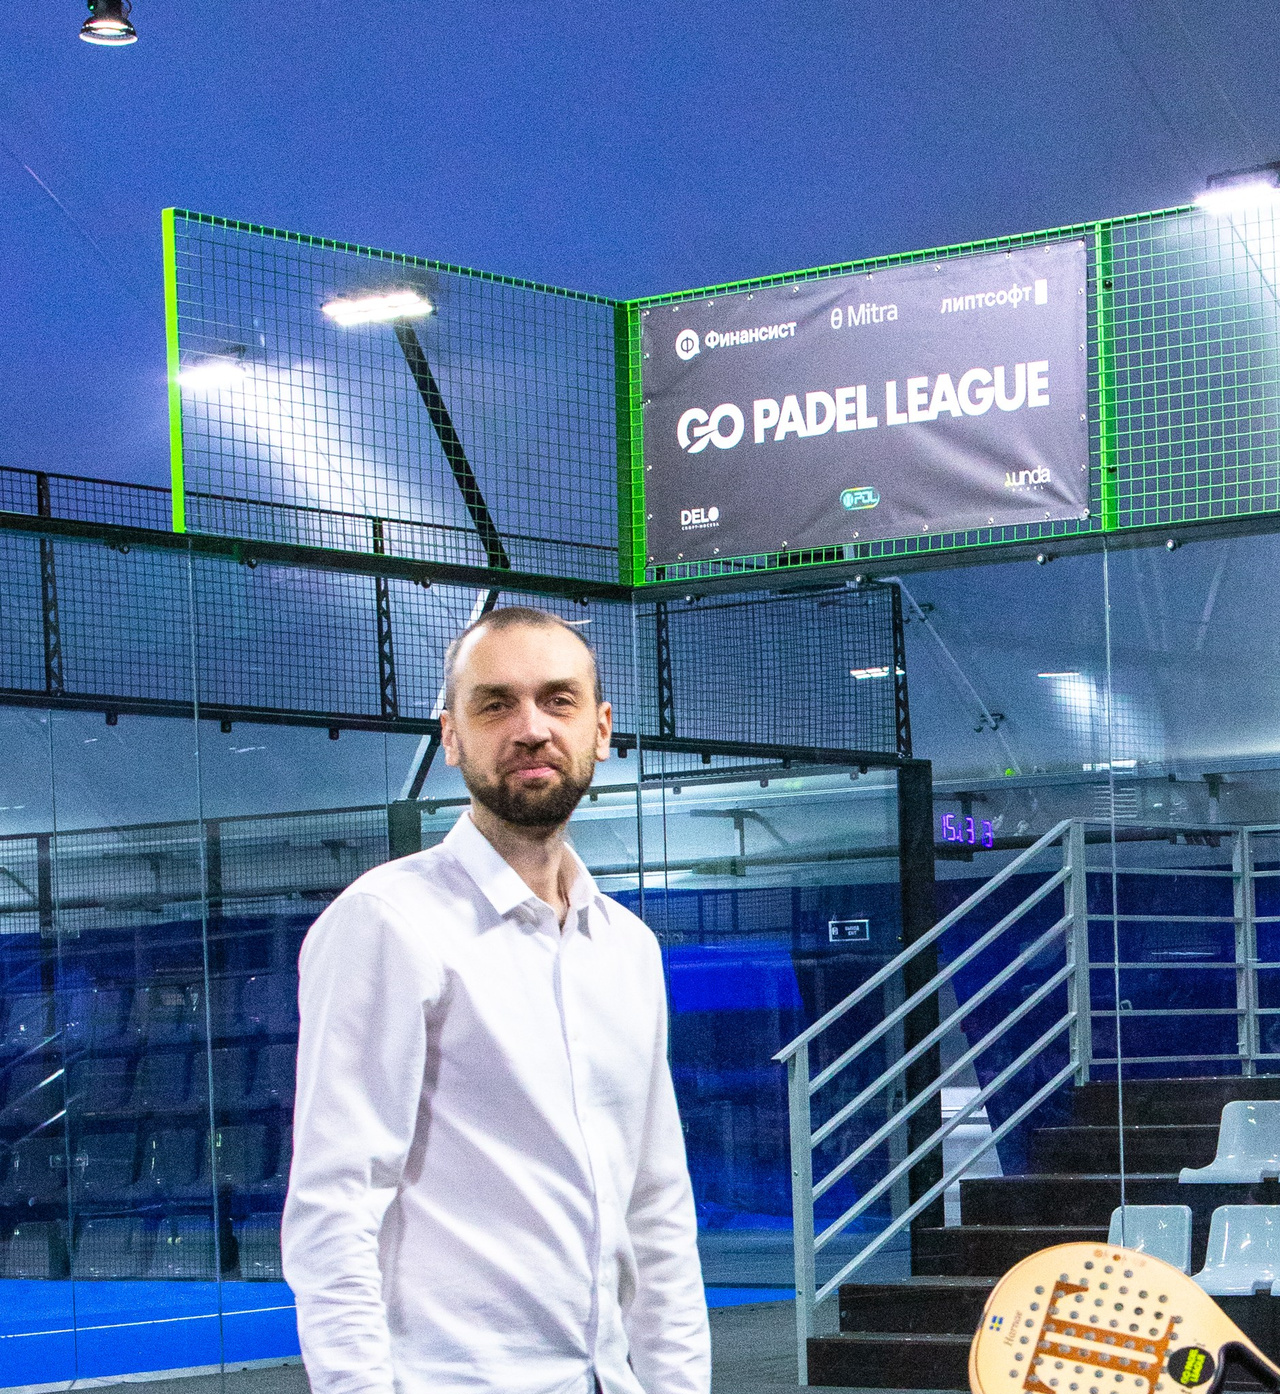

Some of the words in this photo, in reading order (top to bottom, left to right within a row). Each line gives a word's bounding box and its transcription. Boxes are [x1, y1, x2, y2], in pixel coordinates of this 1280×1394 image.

[940, 283, 1033, 314] липтсофт
[848, 303, 898, 327] Mitra
[705, 321, 797, 349] Финансист
[677, 403, 745, 454] GO
[753, 384, 878, 444] PADEL
[886, 360, 1050, 427] LEAGUE
